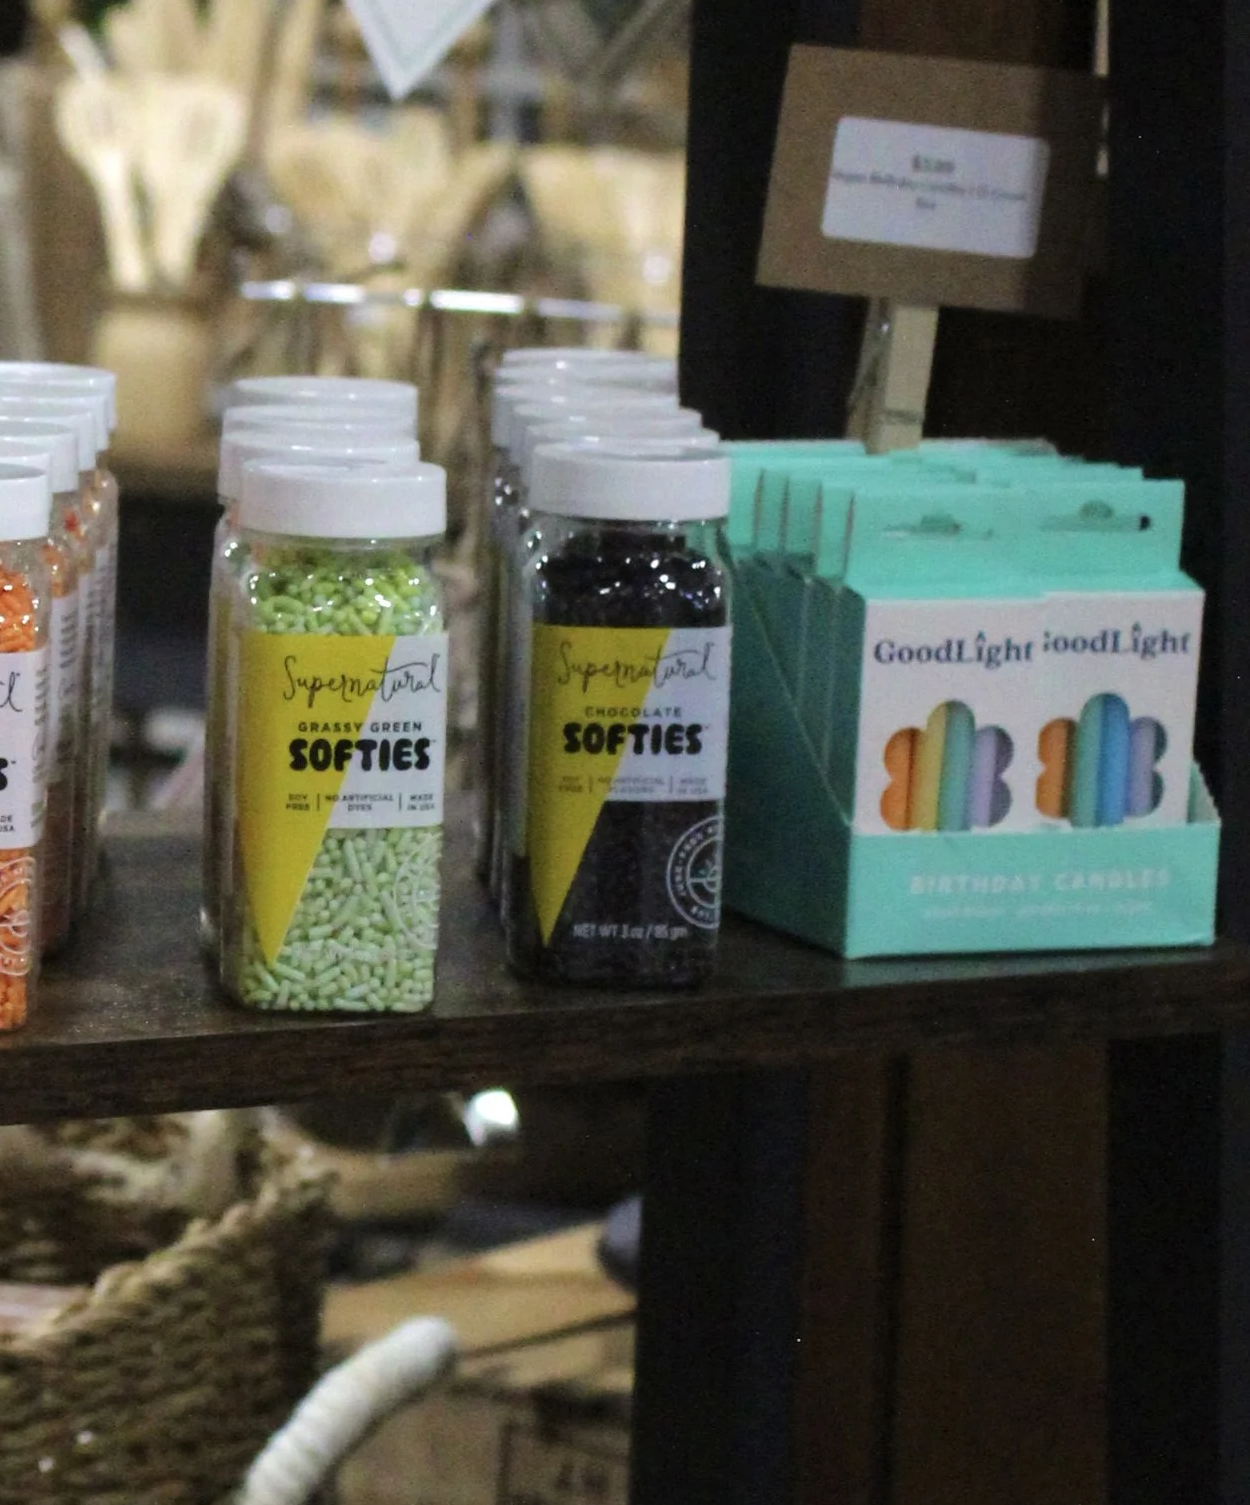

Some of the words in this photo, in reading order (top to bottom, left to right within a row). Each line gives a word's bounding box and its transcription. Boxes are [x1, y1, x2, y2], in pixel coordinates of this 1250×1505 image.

[874, 631, 1033, 670] GoodLight
[1043, 621, 1190, 660] oodLight
[283, 654, 441, 708] Supernatural
[558, 640, 717, 693] Supernatural
[298, 722, 364, 733] GRASSY
[370, 721, 422, 732] GREEN
[584, 706, 682, 718] CHOCOLATE
[289, 738, 431, 772] SOFTIES
[563, 722, 703, 755] SOFTIES
